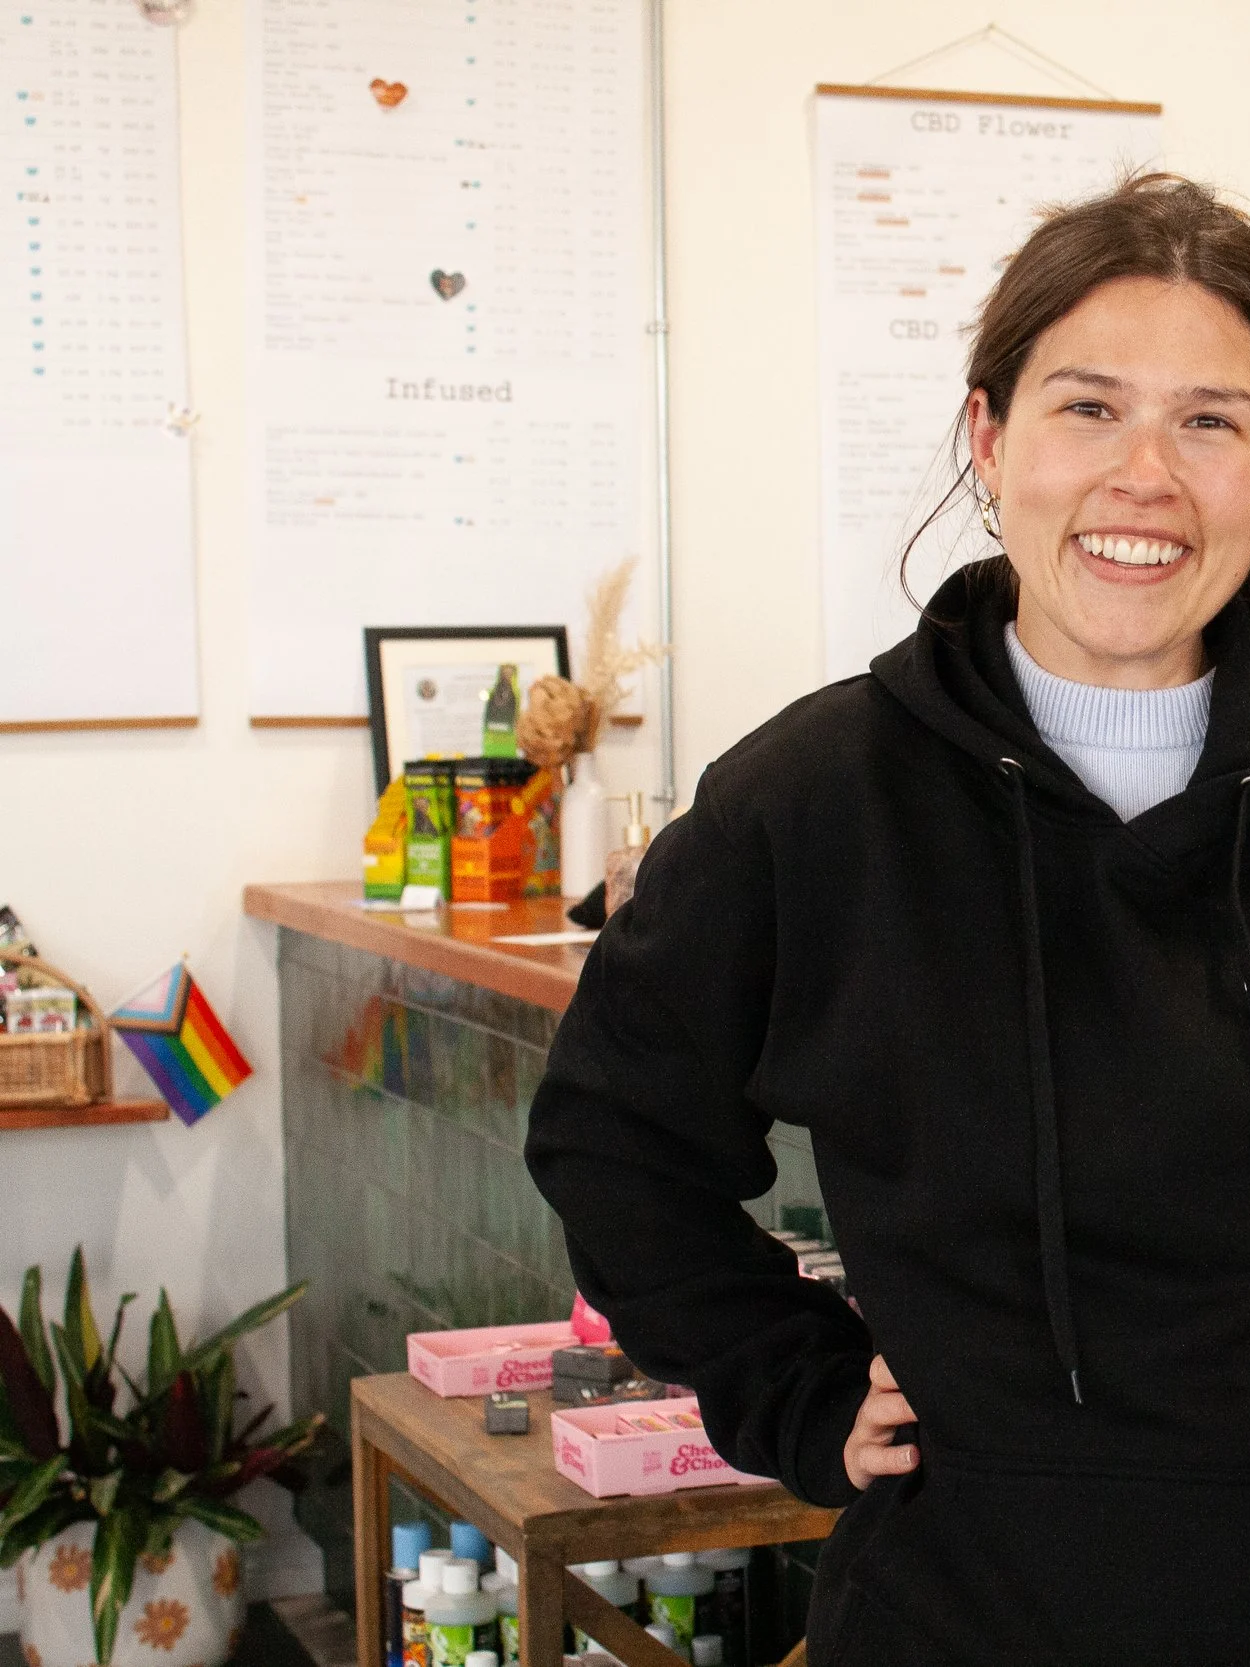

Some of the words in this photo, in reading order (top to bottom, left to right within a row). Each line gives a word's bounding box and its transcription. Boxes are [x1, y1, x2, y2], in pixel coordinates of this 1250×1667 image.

[910, 111, 961, 133] CBD
[978, 113, 1073, 140] Flower
[889, 318, 940, 341] CBD
[384, 376, 513, 403] Infused
